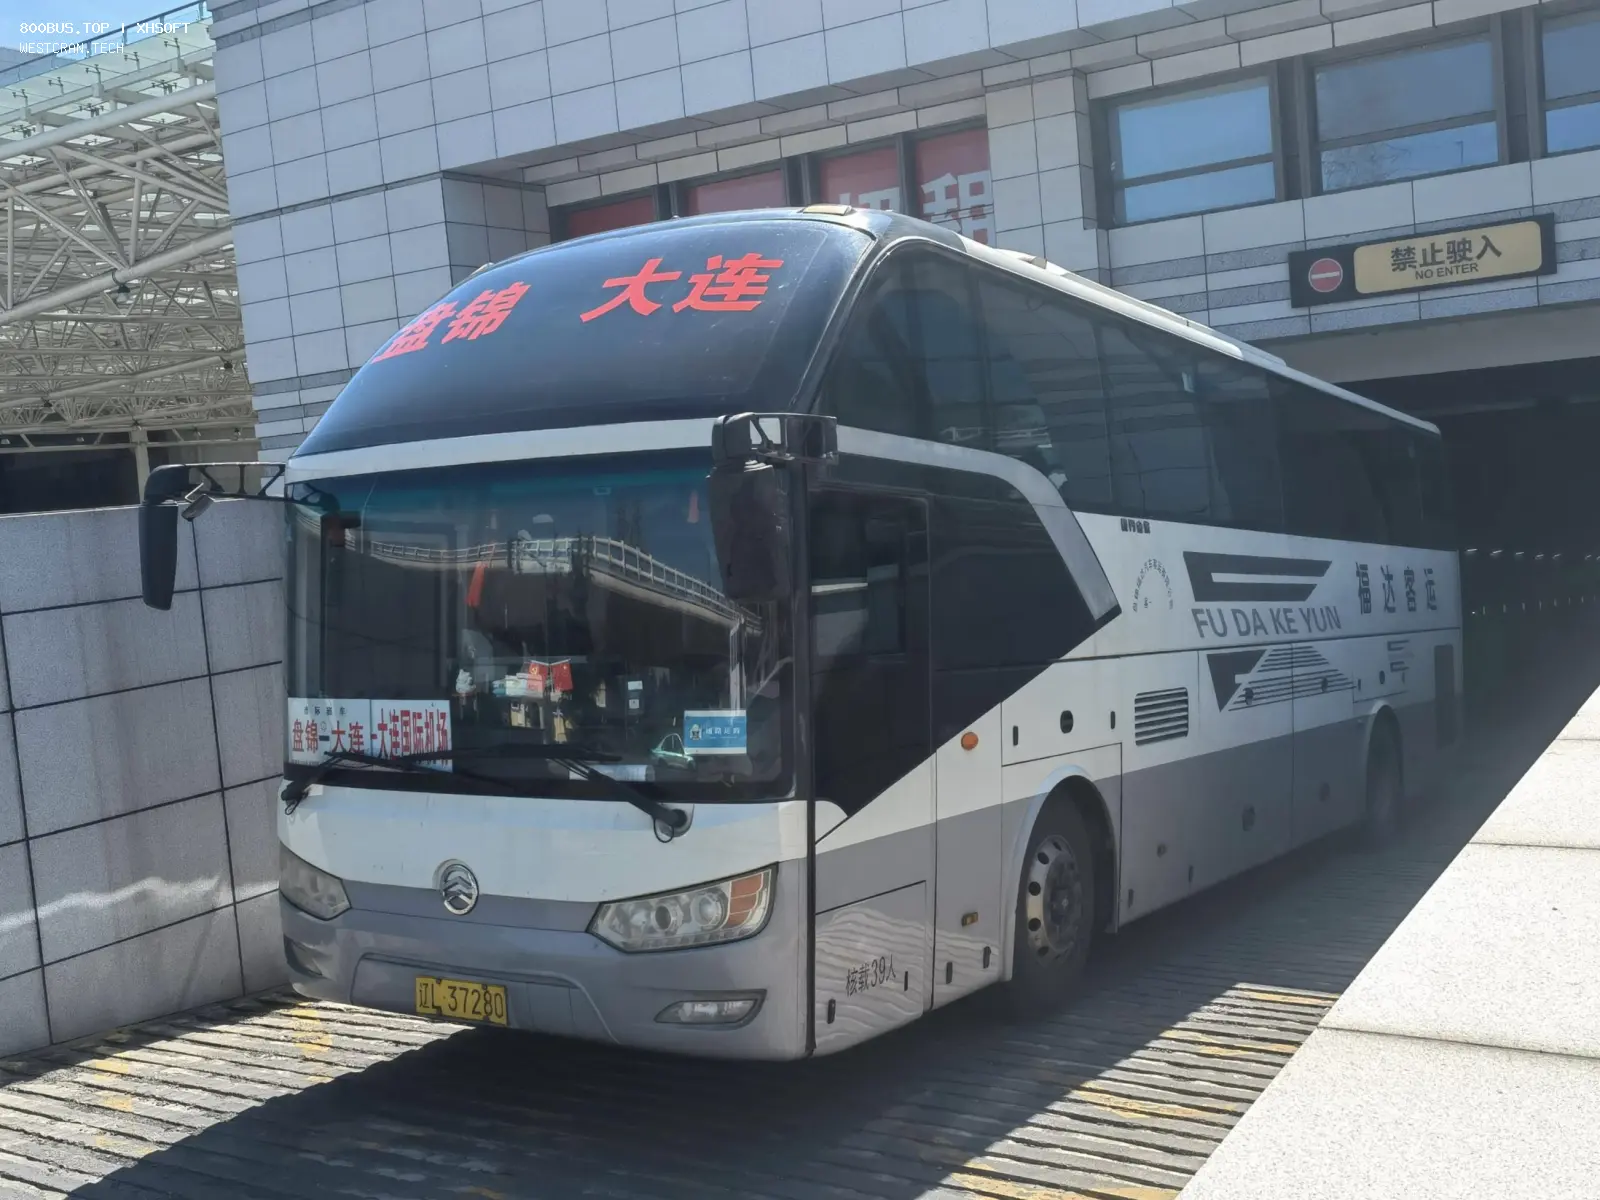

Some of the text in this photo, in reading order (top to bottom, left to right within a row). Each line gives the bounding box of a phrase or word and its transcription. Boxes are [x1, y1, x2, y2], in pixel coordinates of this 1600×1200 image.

[1391, 235, 1502, 271] 禁止驶入
[1415, 262, 1479, 280] NO ENTER
[372, 253, 785, 364] 盘锦 大连
[1355, 561, 1438, 615] 福达客运
[1191, 605, 1342, 638] FU DA KE YUN
[846, 953, 896, 996] 核载39人
